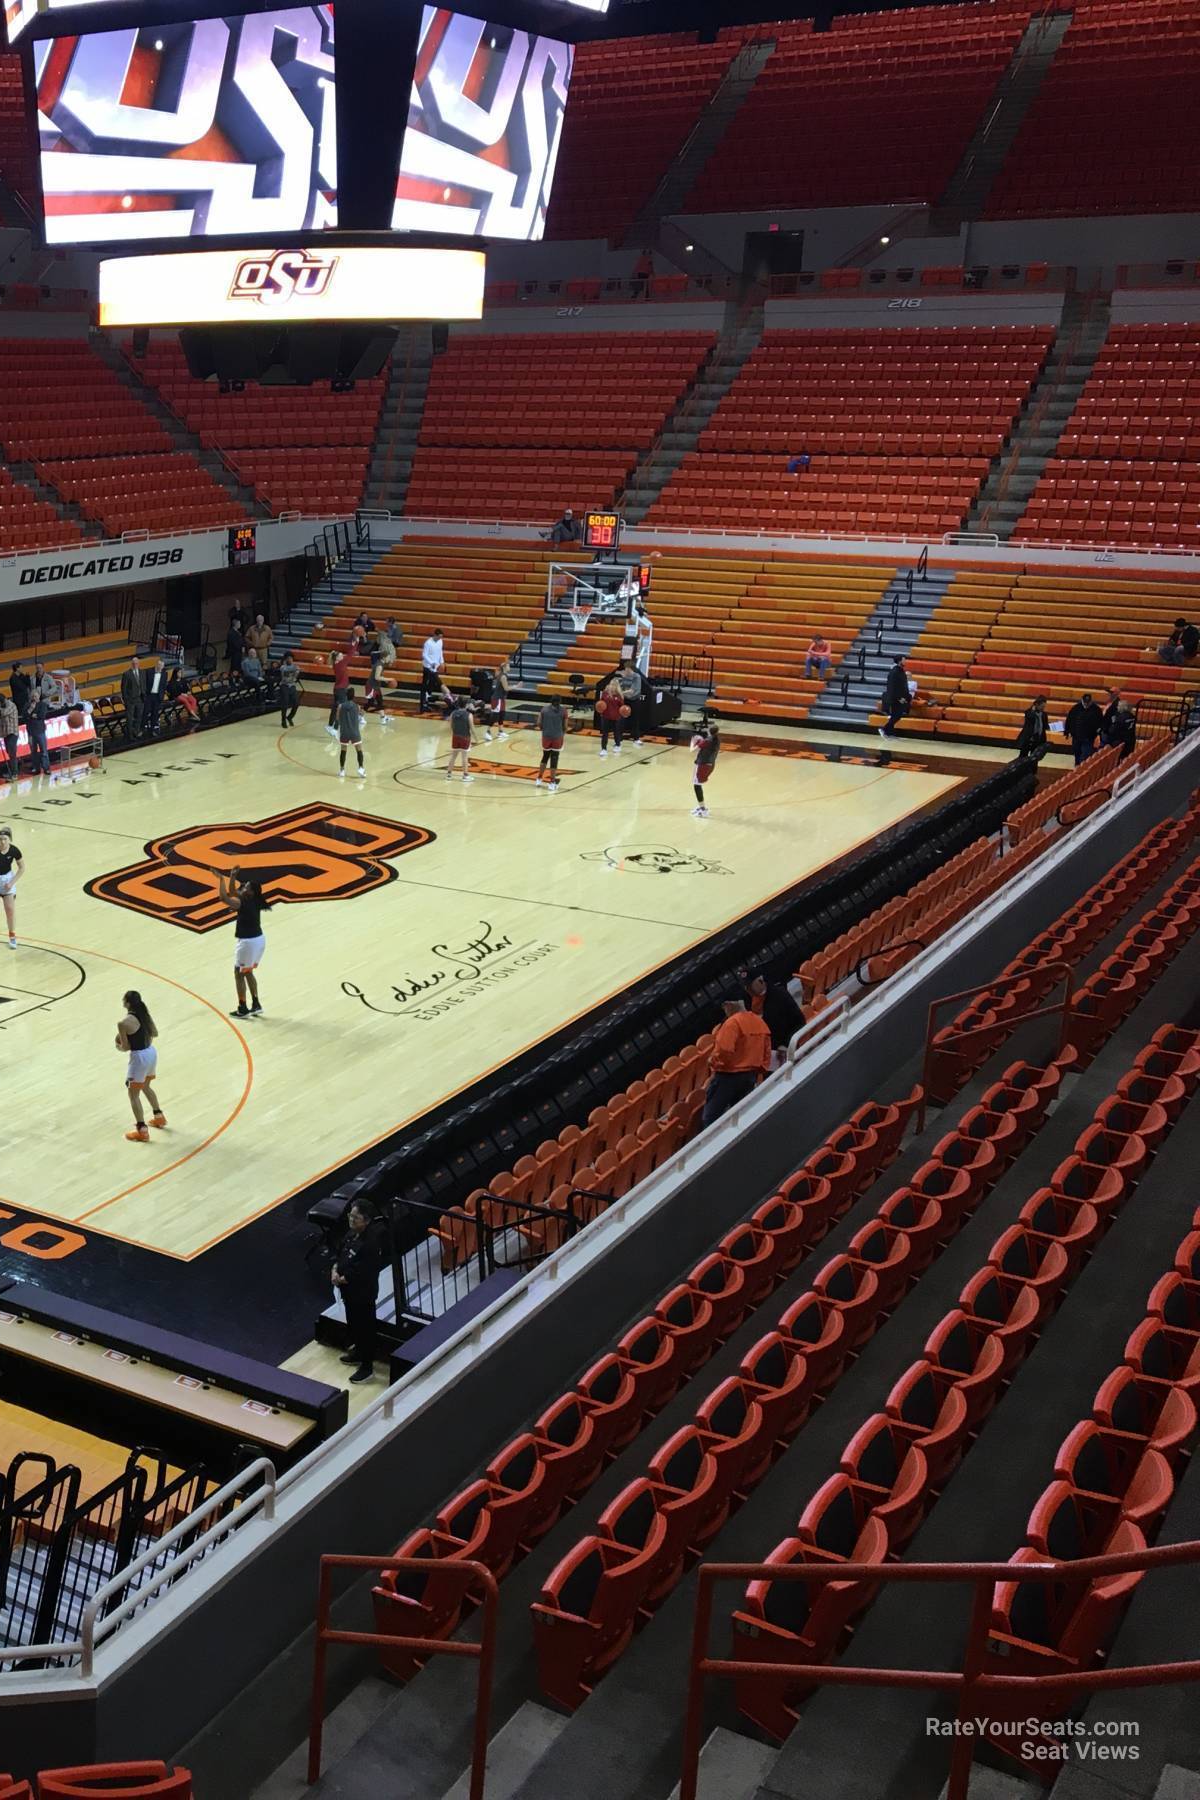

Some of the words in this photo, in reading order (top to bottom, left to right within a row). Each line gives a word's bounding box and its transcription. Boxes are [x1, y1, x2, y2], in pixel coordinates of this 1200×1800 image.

[232, 249, 340, 305] OSU
[887, 298, 922, 308] 218
[588, 515, 616, 526] 60:00
[591, 526, 612, 544] 30
[19, 556, 133, 586] DEDICATED
[139, 548, 184, 569] 1938
[120, 753, 239, 785] ARENA
[88, 803, 434, 931] OSU
[341, 970, 446, 1014] Eddie
[432, 920, 512, 980] Sutton
[414, 996, 465, 1021] EDDIE
[461, 966, 517, 997] SUTTON
[513, 943, 560, 967] COURT
